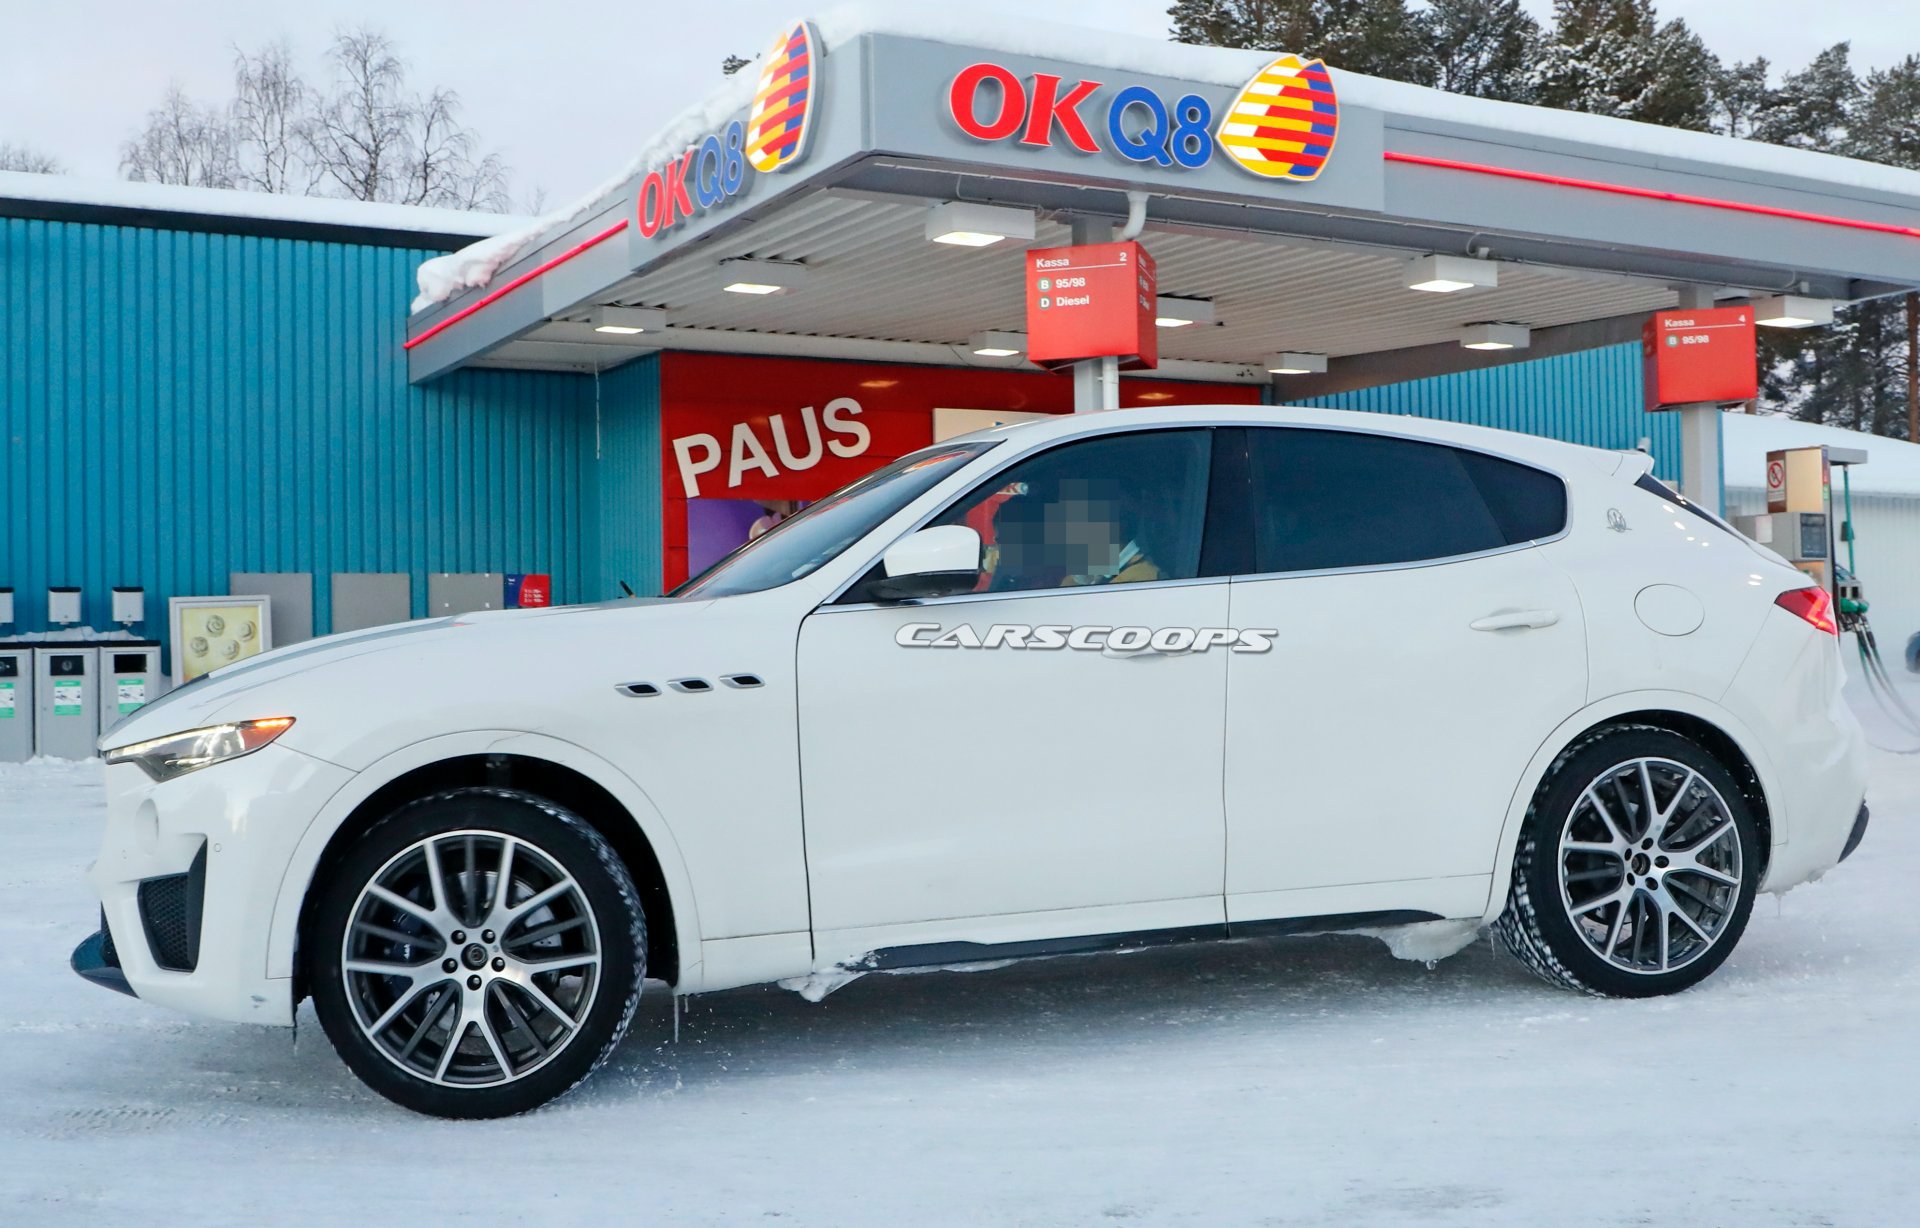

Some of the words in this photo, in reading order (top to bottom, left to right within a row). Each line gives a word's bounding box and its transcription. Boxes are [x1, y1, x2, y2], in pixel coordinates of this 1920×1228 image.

[1036, 258, 1070, 269] Kassa
[1119, 252, 1127, 262] 2
[1055, 277, 1086, 289] 95/98
[1056, 295, 1090, 307] Diesel
[1664, 319, 1695, 328] Kassa
[1738, 314, 1746, 323] 4
[1681, 335, 1710, 345] 95/98
[672, 397, 872, 498] PAUS
